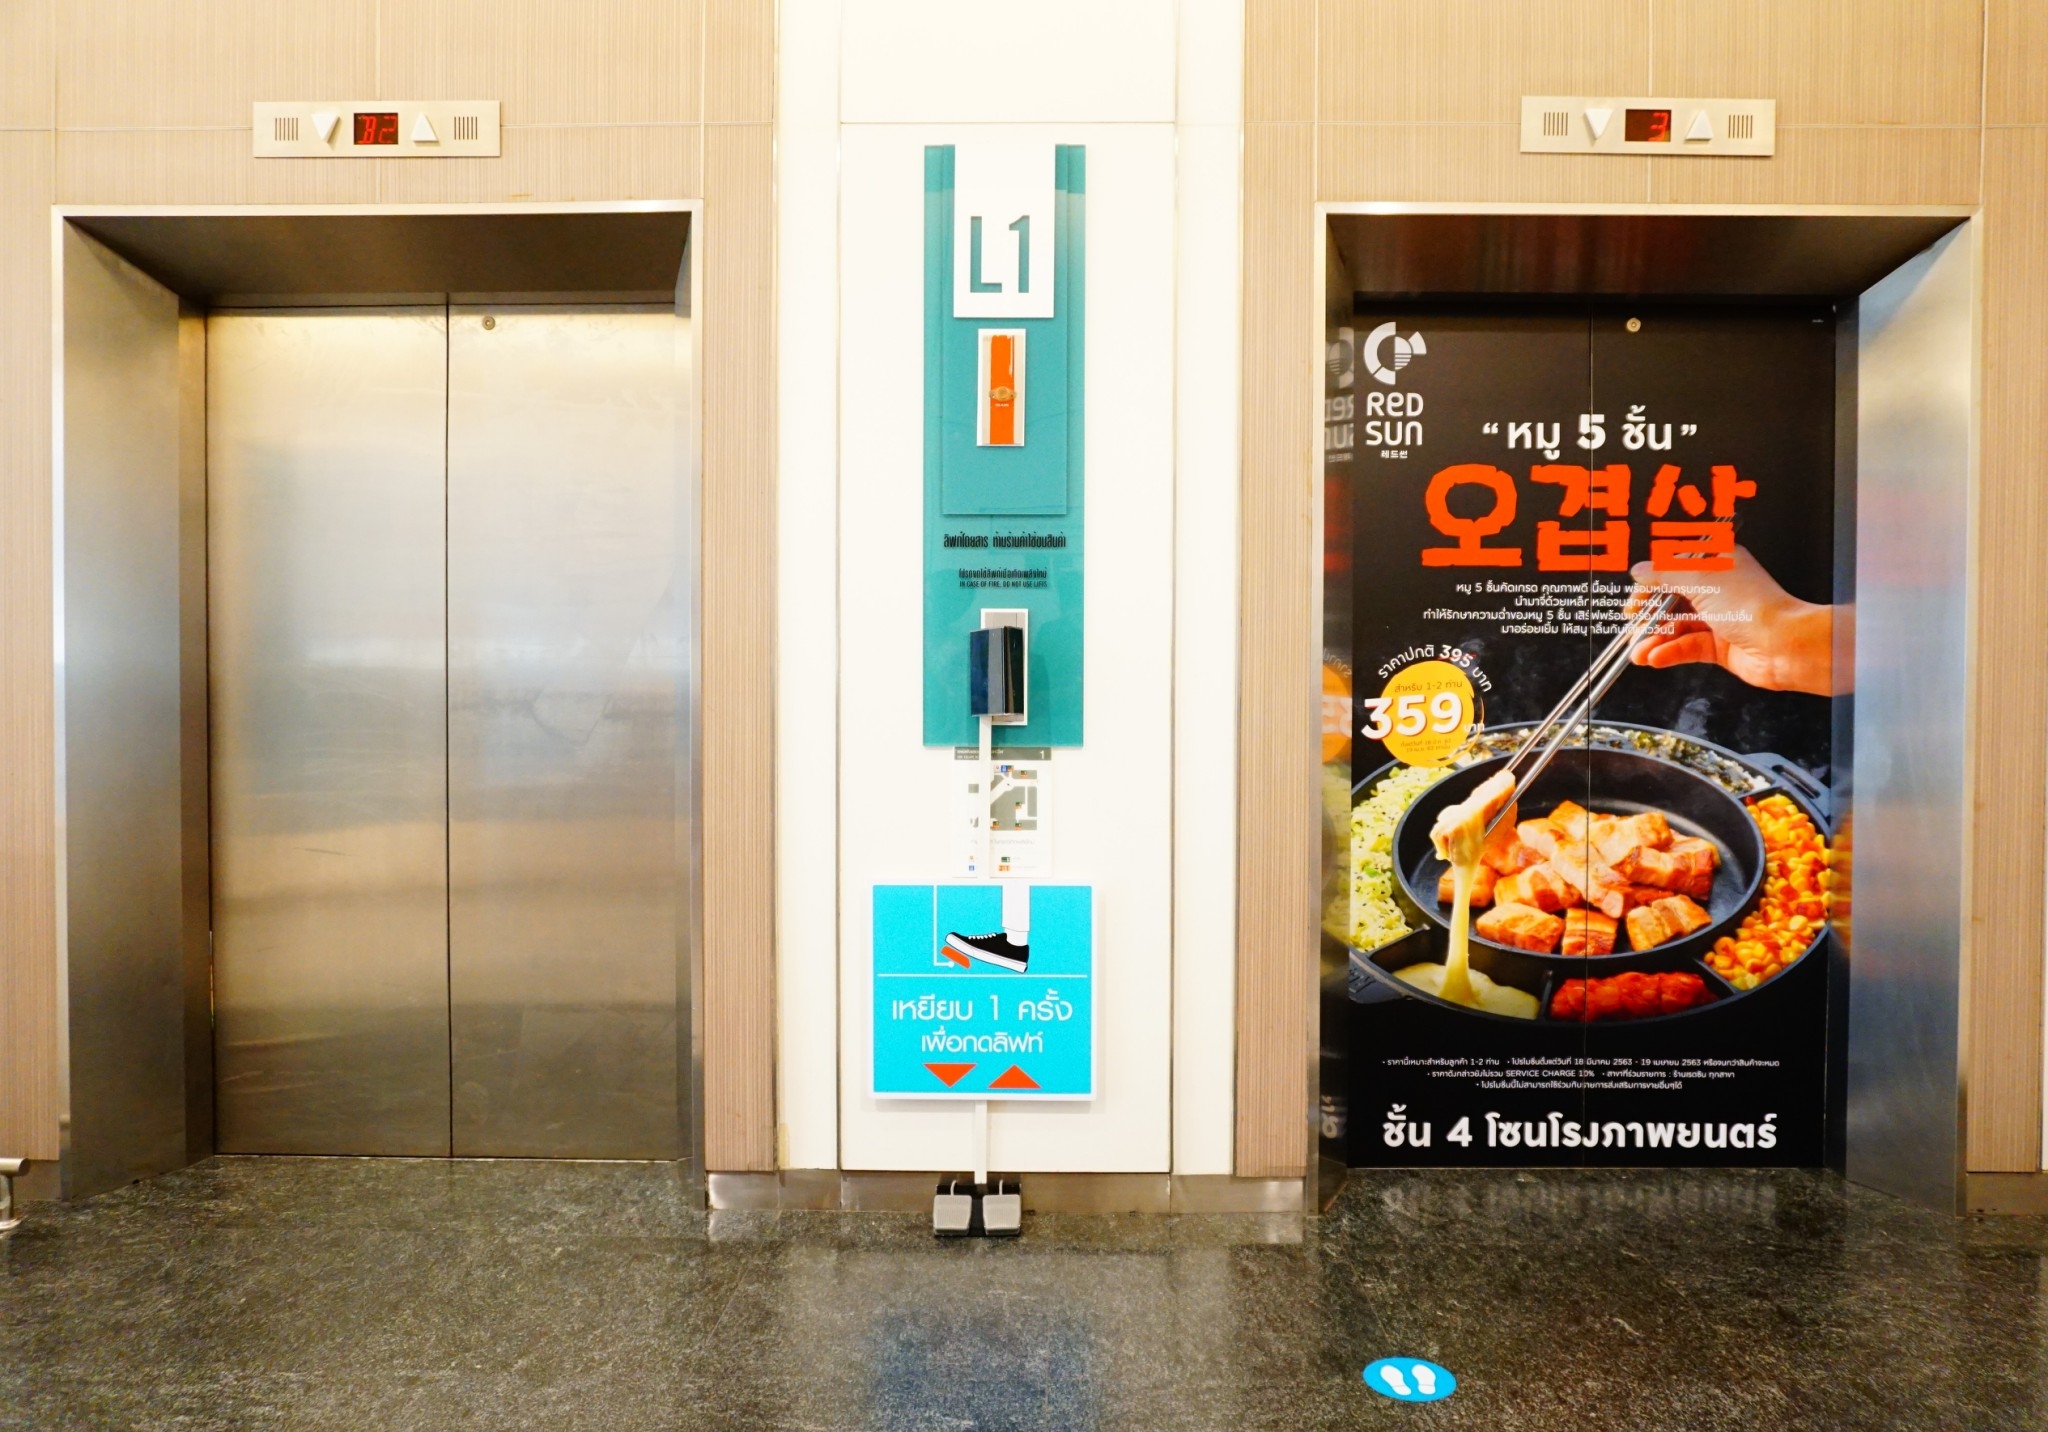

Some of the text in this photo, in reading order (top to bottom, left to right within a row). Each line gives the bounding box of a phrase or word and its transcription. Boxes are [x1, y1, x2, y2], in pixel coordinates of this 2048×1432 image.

[358, 115, 397, 145] B2
[1647, 112, 1669, 142] 3
[970, 215, 1030, 293] L1
[1577, 413, 1606, 450] 5
[1380, 450, 1408, 459] 레드썬
[1421, 463, 1759, 573] 오겹살
[959, 580, 966, 588] IN
[967, 580, 979, 588] CASE
[980, 580, 986, 588] OF
[1002, 580, 1010, 588] DO
[1012, 580, 1021, 588] NOT
[1022, 580, 1032, 588] USE
[1033, 580, 1048, 588] LIFTS
[1456, 583, 1472, 595] หมู
[1475, 582, 1483, 593] 5
[1486, 580, 1538, 593] ชั้นคัดเกรด
[1542, 581, 1589, 597] คุณภาพดี
[1547, 610, 1554, 621] 5
[1557, 607, 1572, 620] ชั้น
[1377, 644, 1493, 693] ราคาปกติ 395 บาท
[1394, 680, 1463, 693] สำหรับ 1-2 ท่าน
[1361, 691, 1463, 740] 359
[1040, 750, 1046, 760] 1
[892, 988, 1073, 1021] เหยียบ 1 ครั้ง
[921, 1025, 1043, 1053] เพื่อกดลิฟท์
[1470, 1058, 1484, 1066] 1-2
[1486, 1058, 1500, 1066] ท่าน
[1574, 1058, 1584, 1066] 18
[1586, 1057, 1611, 1066] มีนาคม
[1613, 1058, 1633, 1066] 2563
[1641, 1058, 1652, 1066] 19
[1682, 1059, 1702, 1067] 2563
[1708, 1071, 1735, 1080] ทุกสาขา
[1382, 1103, 1432, 1148] ชั้น
[1446, 1116, 1473, 1148] 4
[1484, 1112, 1778, 1149] โซนโรงภาพยนตร์
